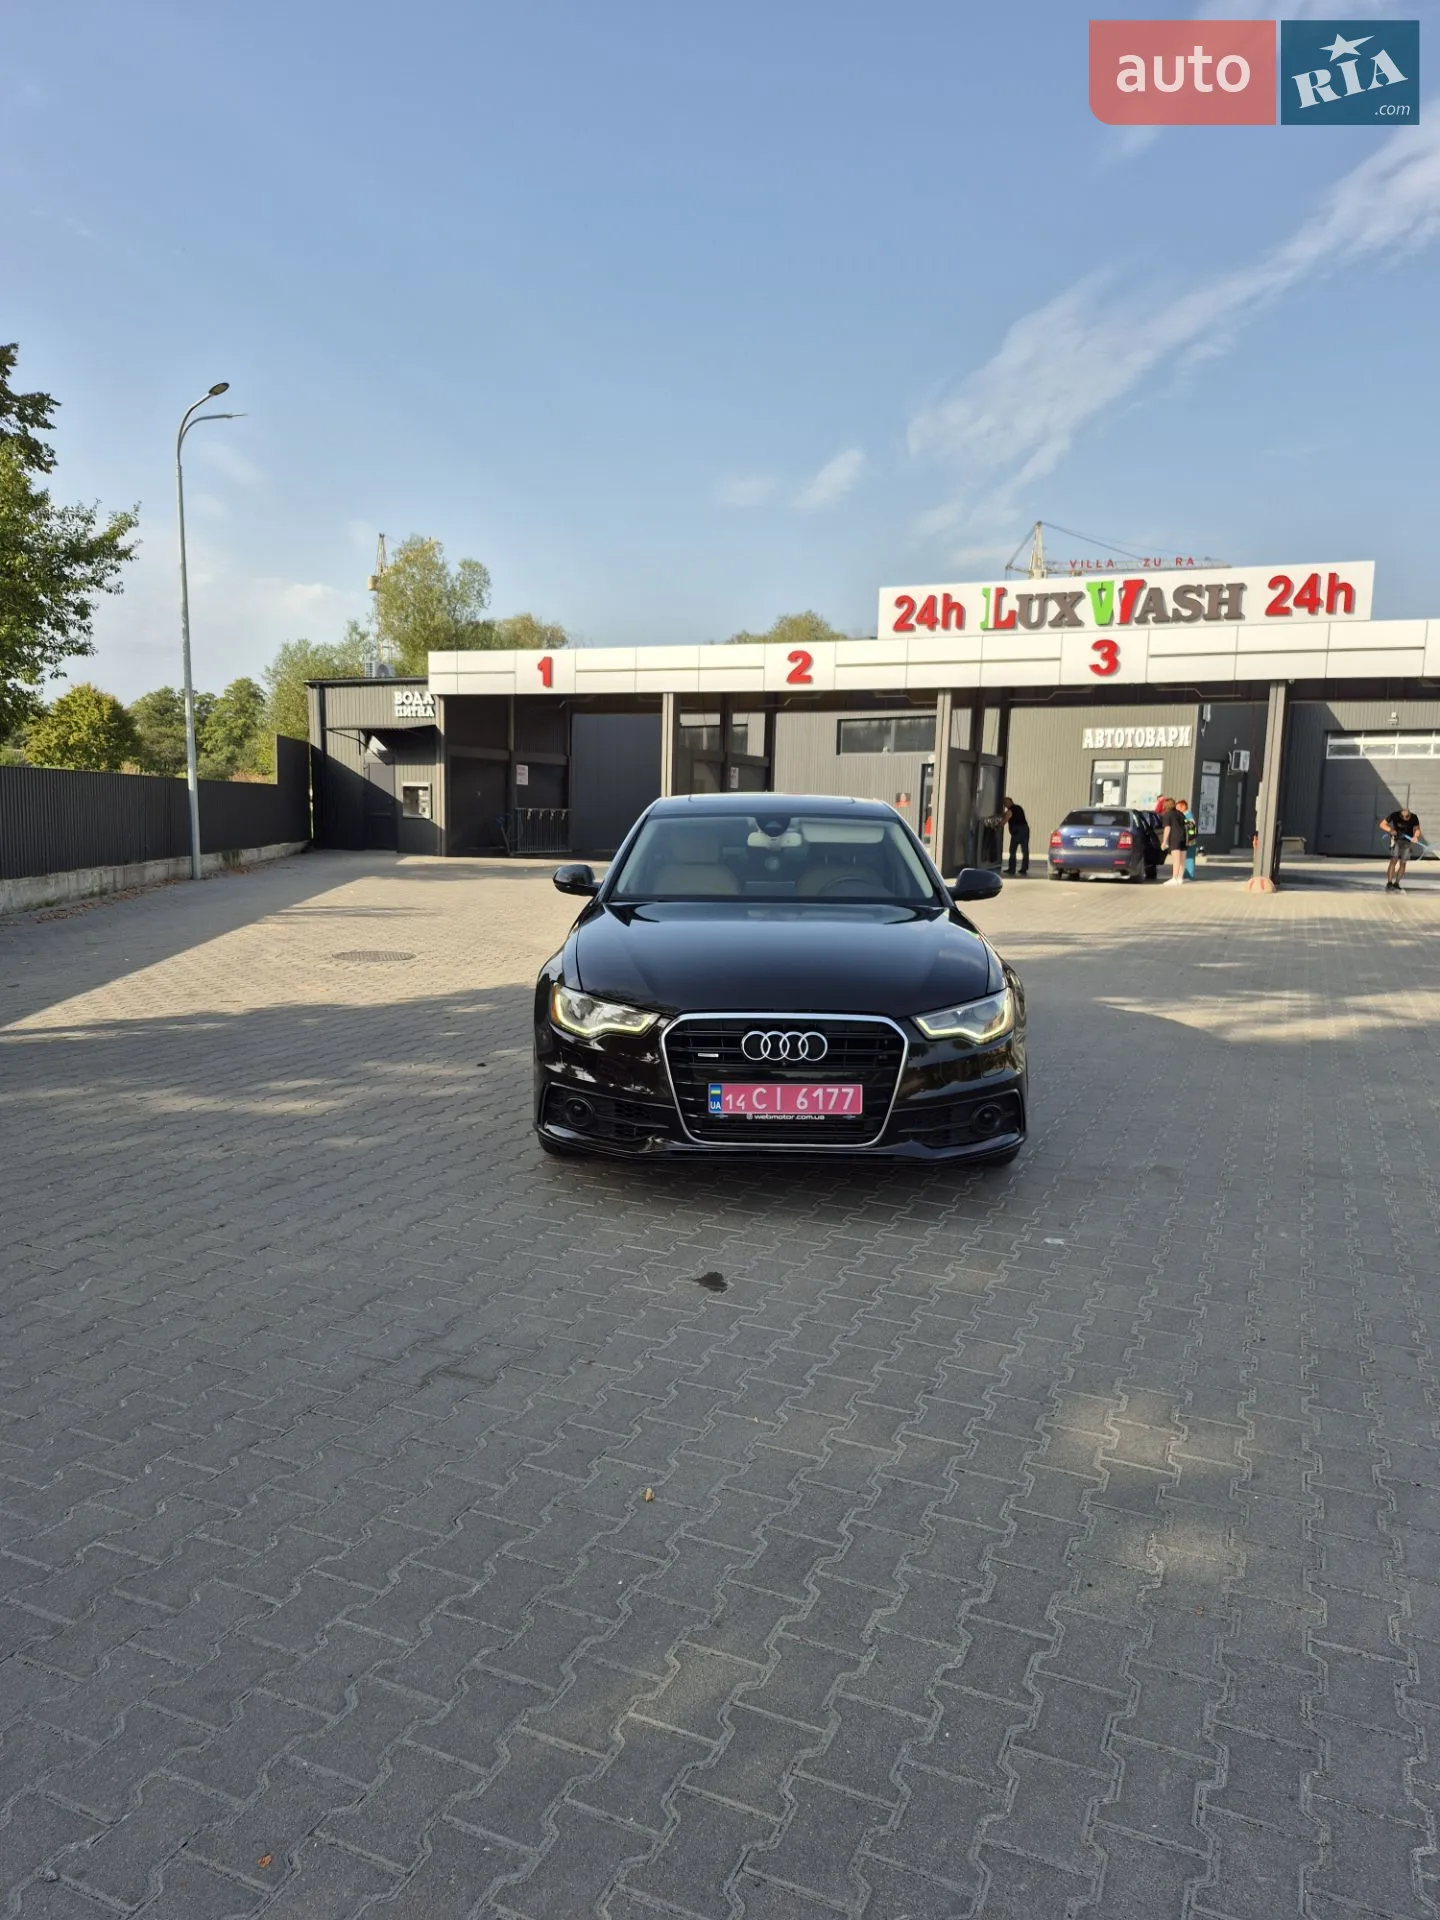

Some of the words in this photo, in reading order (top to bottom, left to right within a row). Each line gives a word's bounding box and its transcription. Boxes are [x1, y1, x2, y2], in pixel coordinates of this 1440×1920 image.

[1069, 558, 1115, 569] VILLA
[893, 593, 966, 632] 24h
[1265, 573, 1356, 617] 24h
[786, 650, 813, 685] 2
[1089, 639, 1120, 677] 3
[537, 656, 553, 688] 1
[394, 690, 435, 705] ВОДА
[395, 705, 435, 717] ПИТНА
[1083, 725, 1192, 749] АВТОТОВАРИ
[710, 1101, 721, 1110] UA
[796, 1087, 855, 1110] 6177
